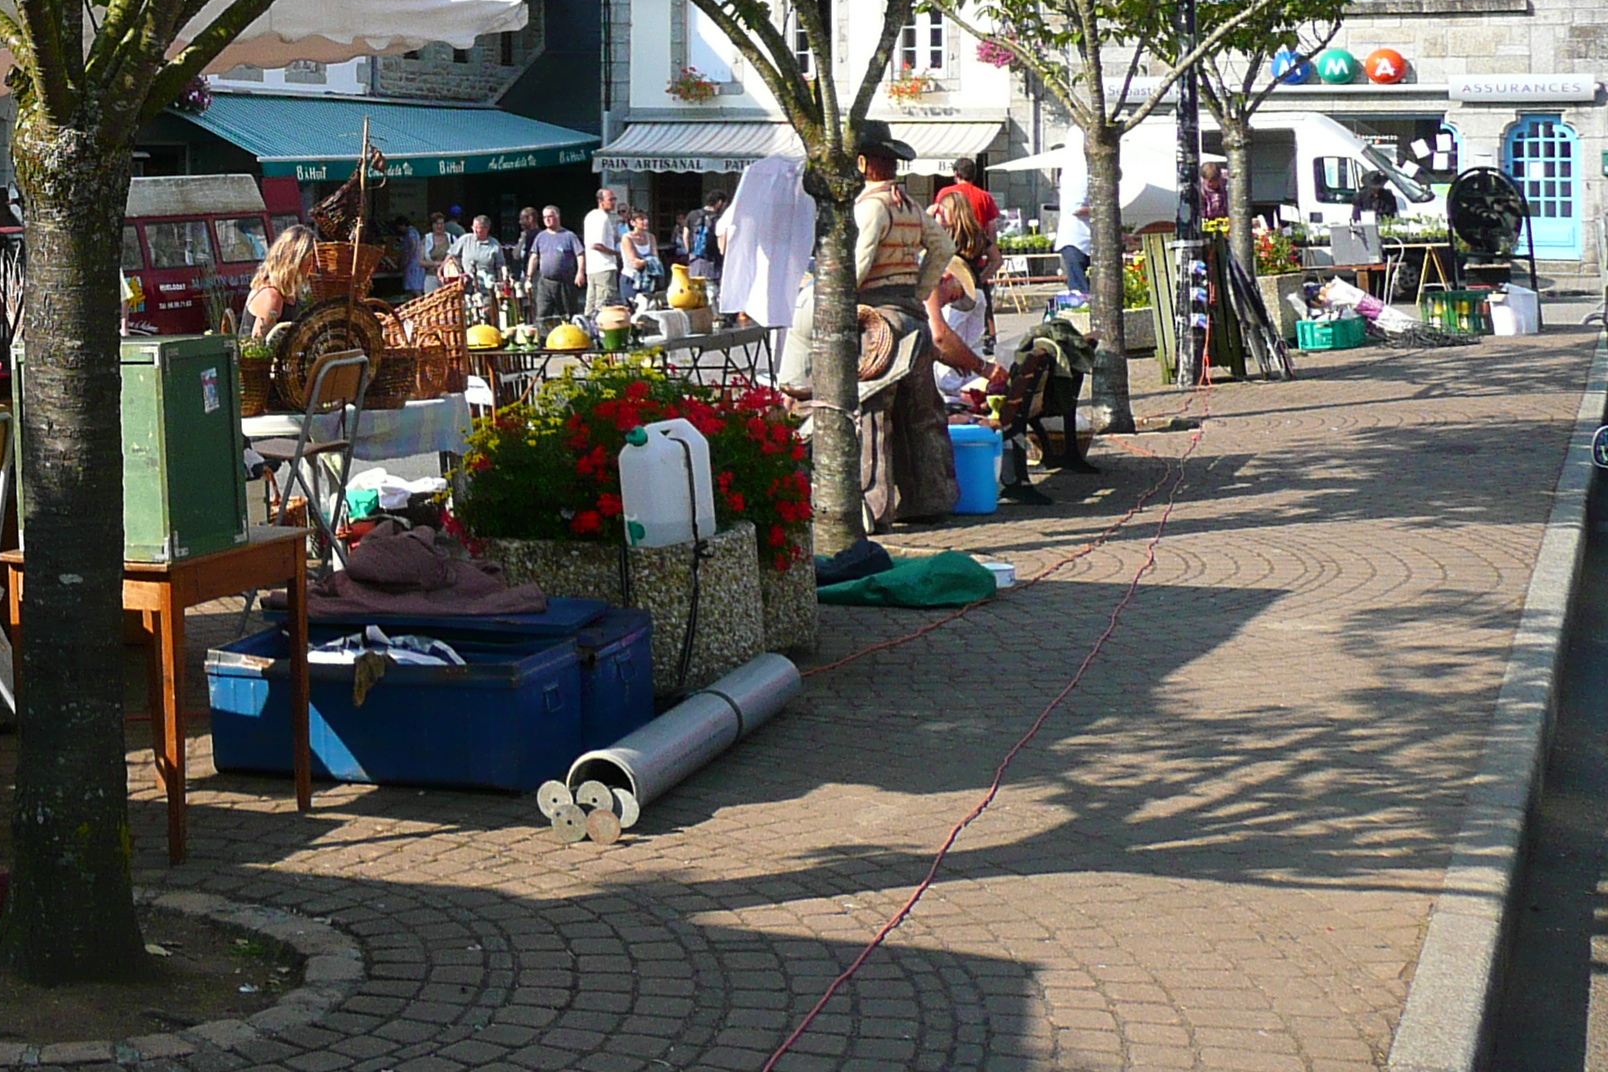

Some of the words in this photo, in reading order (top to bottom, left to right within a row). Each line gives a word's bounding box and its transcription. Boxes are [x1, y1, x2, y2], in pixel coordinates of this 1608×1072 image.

[1461, 83, 1582, 94] ASSURANCES
[601, 158, 629, 169] PAIN
[634, 158, 703, 170] ARTISANAL
